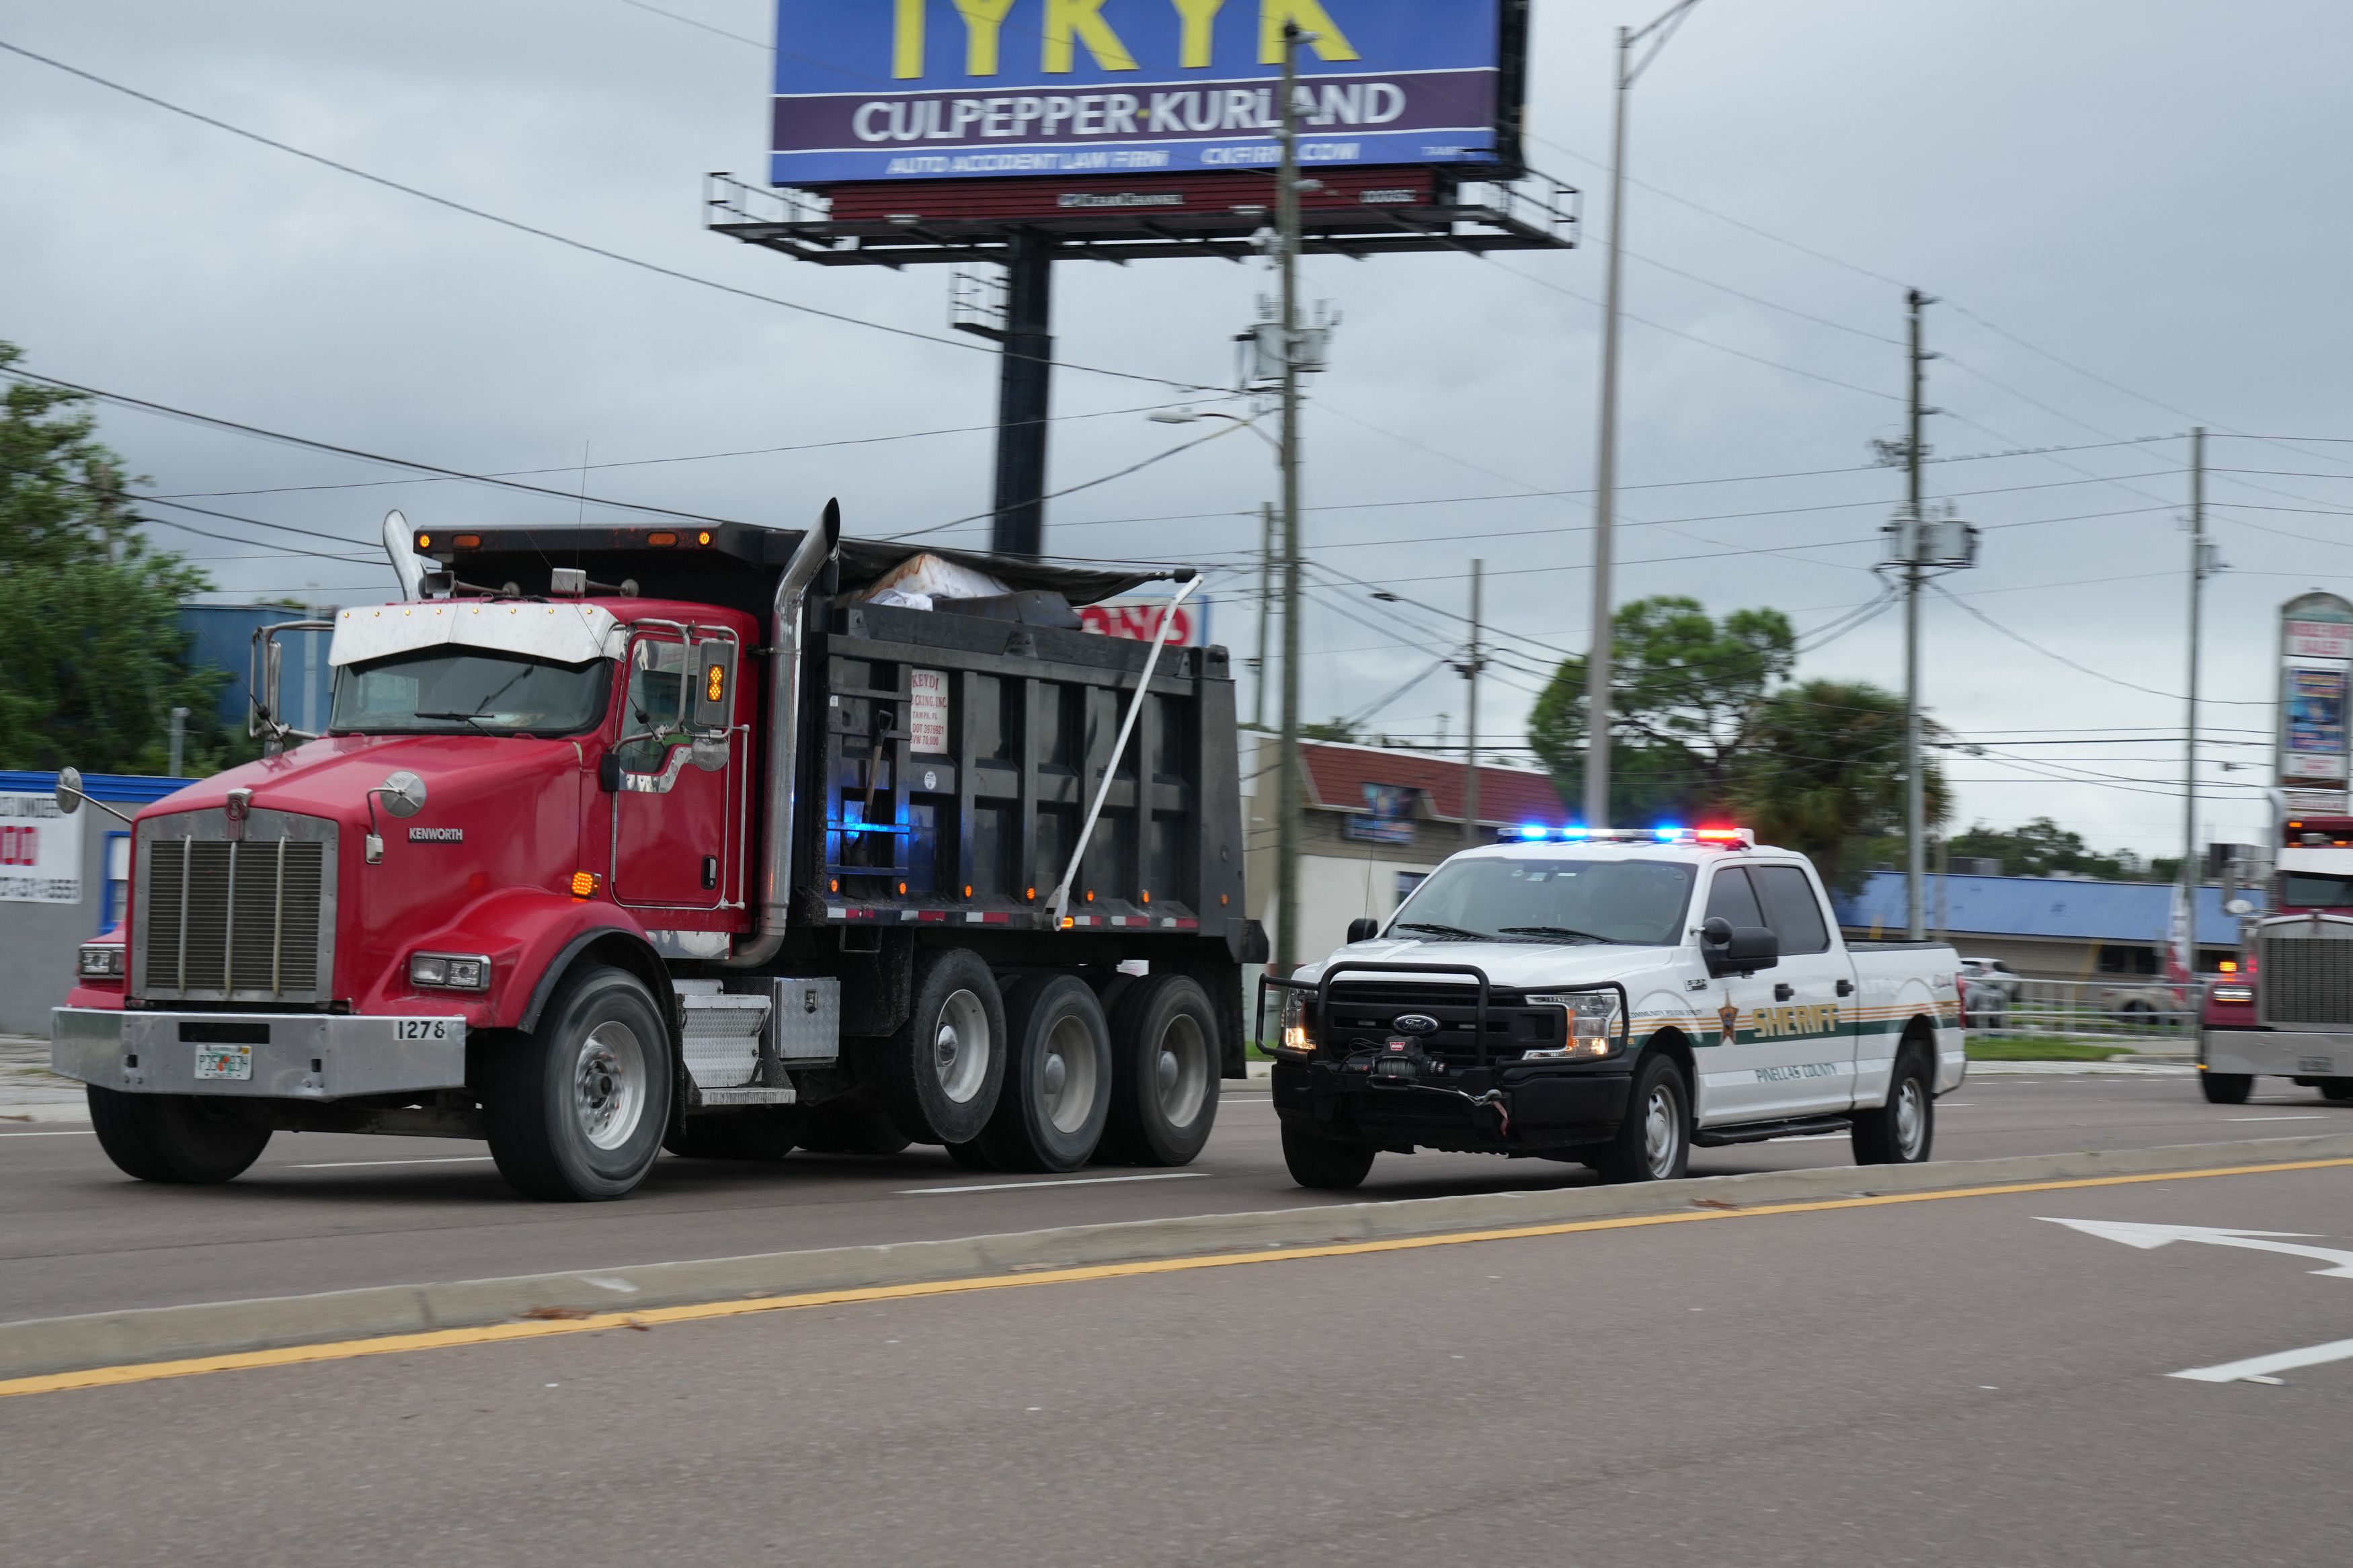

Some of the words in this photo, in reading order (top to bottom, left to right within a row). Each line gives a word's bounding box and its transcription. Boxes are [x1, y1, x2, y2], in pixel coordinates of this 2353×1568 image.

[885, 157, 949, 175] AUTO
[951, 153, 1060, 171] ACCIDENT
[1060, 152, 1109, 169] LAW
[1111, 151, 1170, 167] FIRM
[409, 827, 463, 840] KENWORTH
[1403, 1018, 1427, 1030] Ford
[1753, 1003, 1839, 1038] SHERIFF
[1755, 1065, 1801, 1083] PINELLAS
[1802, 1063, 1837, 1078] COUNTY
